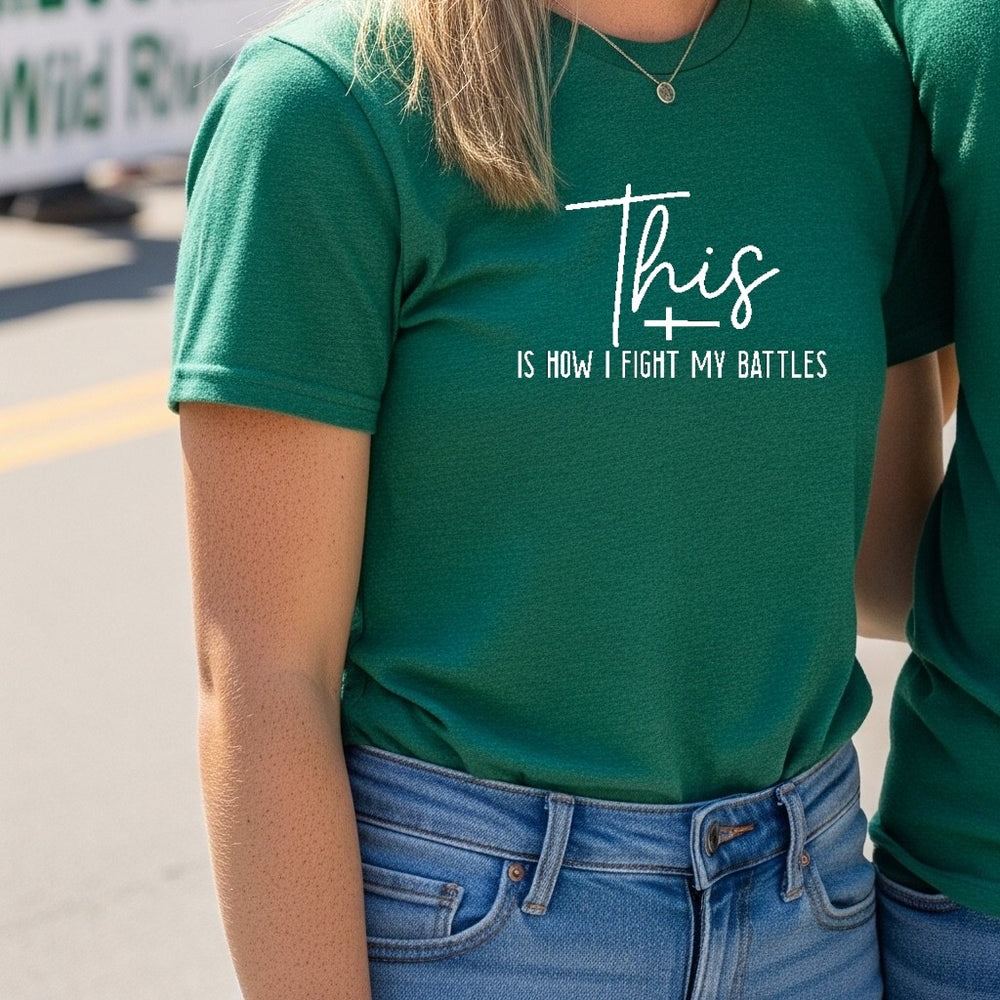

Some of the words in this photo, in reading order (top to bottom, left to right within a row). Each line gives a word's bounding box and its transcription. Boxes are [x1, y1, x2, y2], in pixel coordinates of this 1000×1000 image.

[564, 183, 780, 348] This
[517, 350, 535, 379] IS
[547, 350, 594, 379] HOW
[604, 350, 611, 379] I
[622, 350, 680, 379] FIGHT
[691, 350, 726, 379] MY
[738, 350, 827, 379] BATTLES
